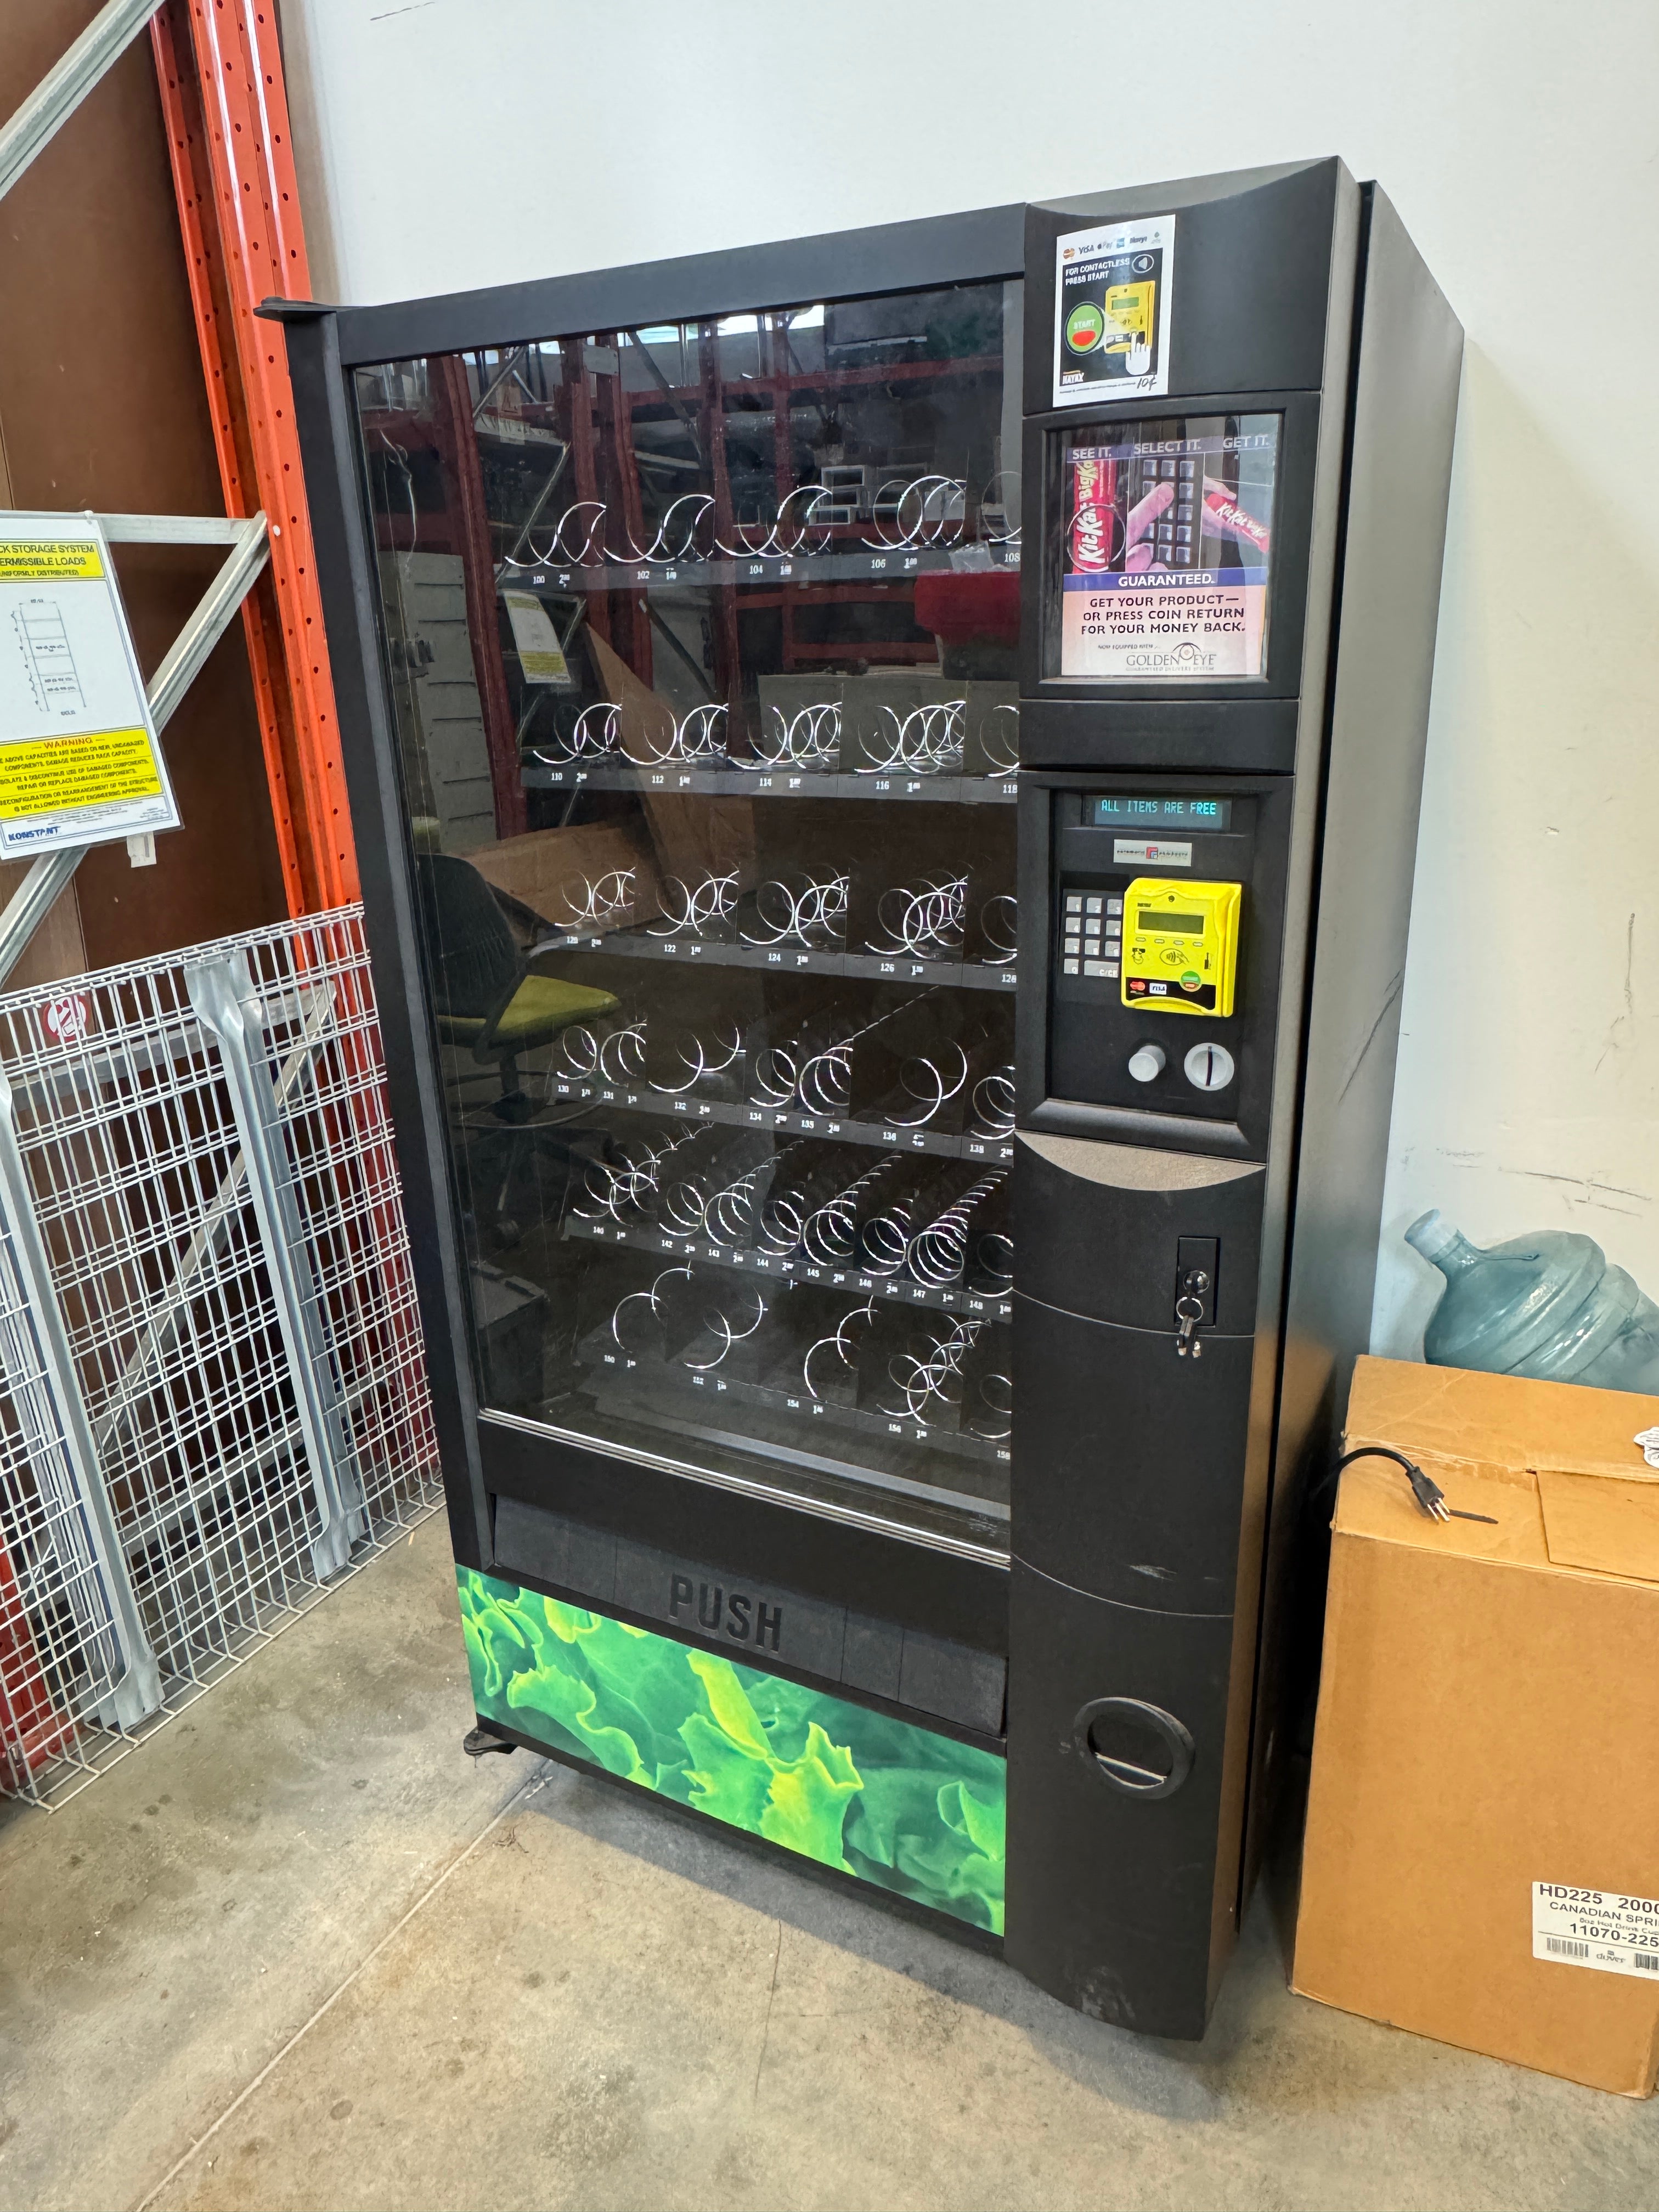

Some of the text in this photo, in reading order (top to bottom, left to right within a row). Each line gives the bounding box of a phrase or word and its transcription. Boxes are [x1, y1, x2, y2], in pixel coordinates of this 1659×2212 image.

[1065, 257, 1130, 276] FOR CONTACTLESS
[1065, 270, 1109, 286] PRESS START
[1073, 319, 1096, 329] START
[1133, 438, 1201, 455] SELECT IT.
[1223, 434, 1270, 449] GET IT.
[1073, 446, 1111, 460] SEE IT.
[12, 545, 58, 554] STORAGE
[58, 545, 94, 553] SYSTEM
[55, 557, 86, 566] LOADS
[1004, 552, 1020, 563] 108
[871, 558, 886, 569] 106
[749, 565, 763, 574] 104
[533, 575, 545, 584] 100
[637, 570, 650, 580] 102
[1118, 573, 1216, 587] GUARANTEED.
[1090, 598, 1114, 607] GET
[1118, 597, 1154, 606] YOUR
[1083, 608, 1244, 621] OR PRESS COIN RETURN
[1081, 622, 1246, 635] FOR YOUR MONEY BACK.
[1126, 653, 1217, 666] GOLDEN EYE
[44, 737, 93, 749] WARNING
[551, 772, 563, 781] 110
[652, 775, 664, 784] 112
[759, 777, 772, 787] 114
[876, 781, 890, 791] 116
[1101, 799, 1217, 815] ALL ITEMS ARE FREE
[664, 944, 676, 953] 122
[768, 953, 781, 962] 124
[880, 963, 895, 973] 126
[557, 1085, 569, 1093] 130
[603, 1091, 614, 1100] 131
[749, 1112, 762, 1121] 134
[661, 1239, 673, 1248] 142
[806, 1268, 820, 1278] 145
[912, 1289, 927, 1299] 147
[669, 1572, 782, 1654] PUSH
[1539, 1883, 1602, 1904] HD225
[1550, 1901, 1659, 1927] CANADIAN SPRI
[1570, 1923, 1659, 1947] 11070-225
